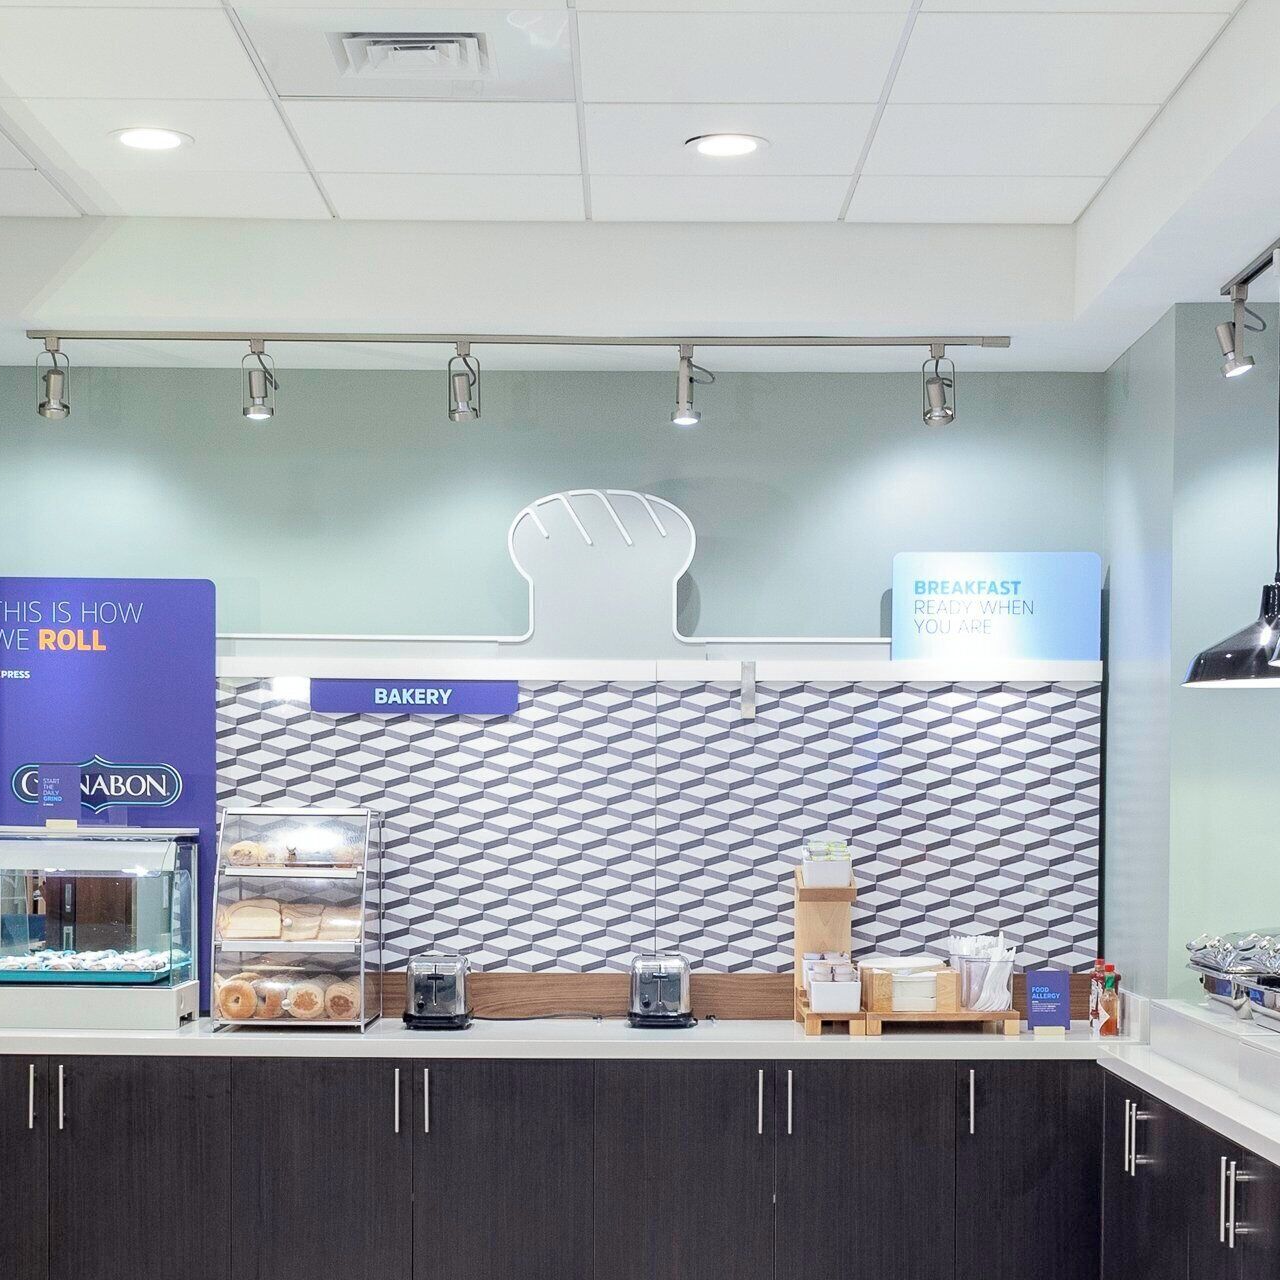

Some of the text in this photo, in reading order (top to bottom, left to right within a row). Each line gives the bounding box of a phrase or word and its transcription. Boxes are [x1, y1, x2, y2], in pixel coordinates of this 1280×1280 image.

[914, 580, 1022, 596] BREAKFAST
[52, 601, 73, 623] IS
[81, 601, 144, 624] HOW
[914, 599, 1035, 615] READY WHEN
[913, 618, 992, 635] YOU ARE
[38, 628, 107, 651] ROLL
[374, 687, 453, 705] BAKERY
[21, 770, 168, 798] CNABON
